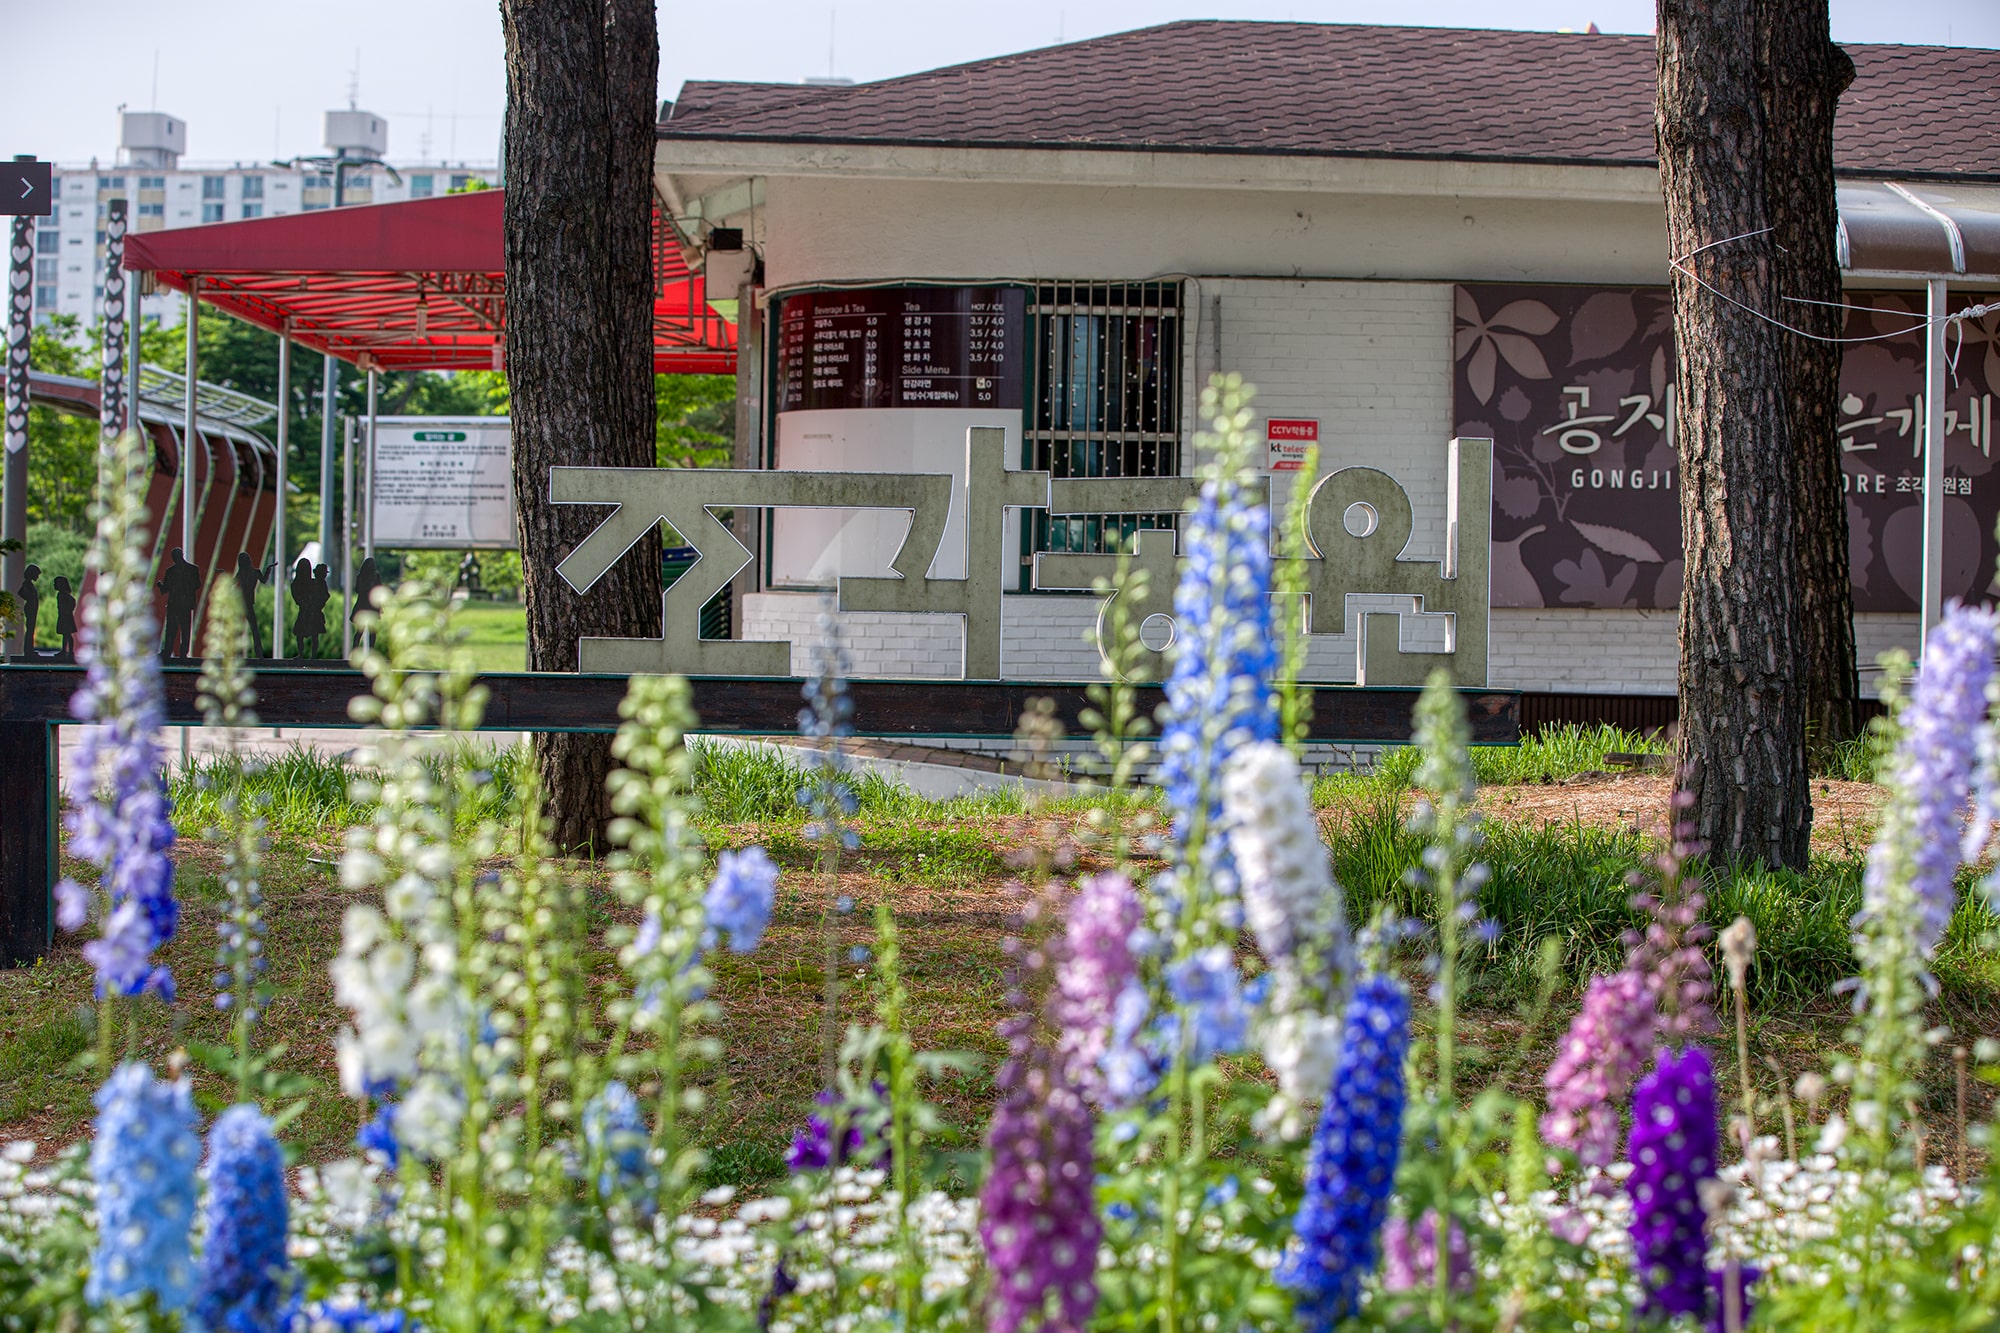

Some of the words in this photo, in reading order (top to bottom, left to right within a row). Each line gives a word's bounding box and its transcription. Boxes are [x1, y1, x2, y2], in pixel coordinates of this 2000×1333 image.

[814, 306, 843, 315] Beverage
[852, 304, 865, 313] Tea
[904, 302, 920, 311] Tea
[902, 365, 922, 374] Side
[924, 365, 950, 374] Menu
[903, 379, 932, 388] 한강라면
[1270, 443, 1282, 453] kt
[1572, 469, 1671, 489] GONGJI
[1896, 476, 1972, 495] 조각원점
